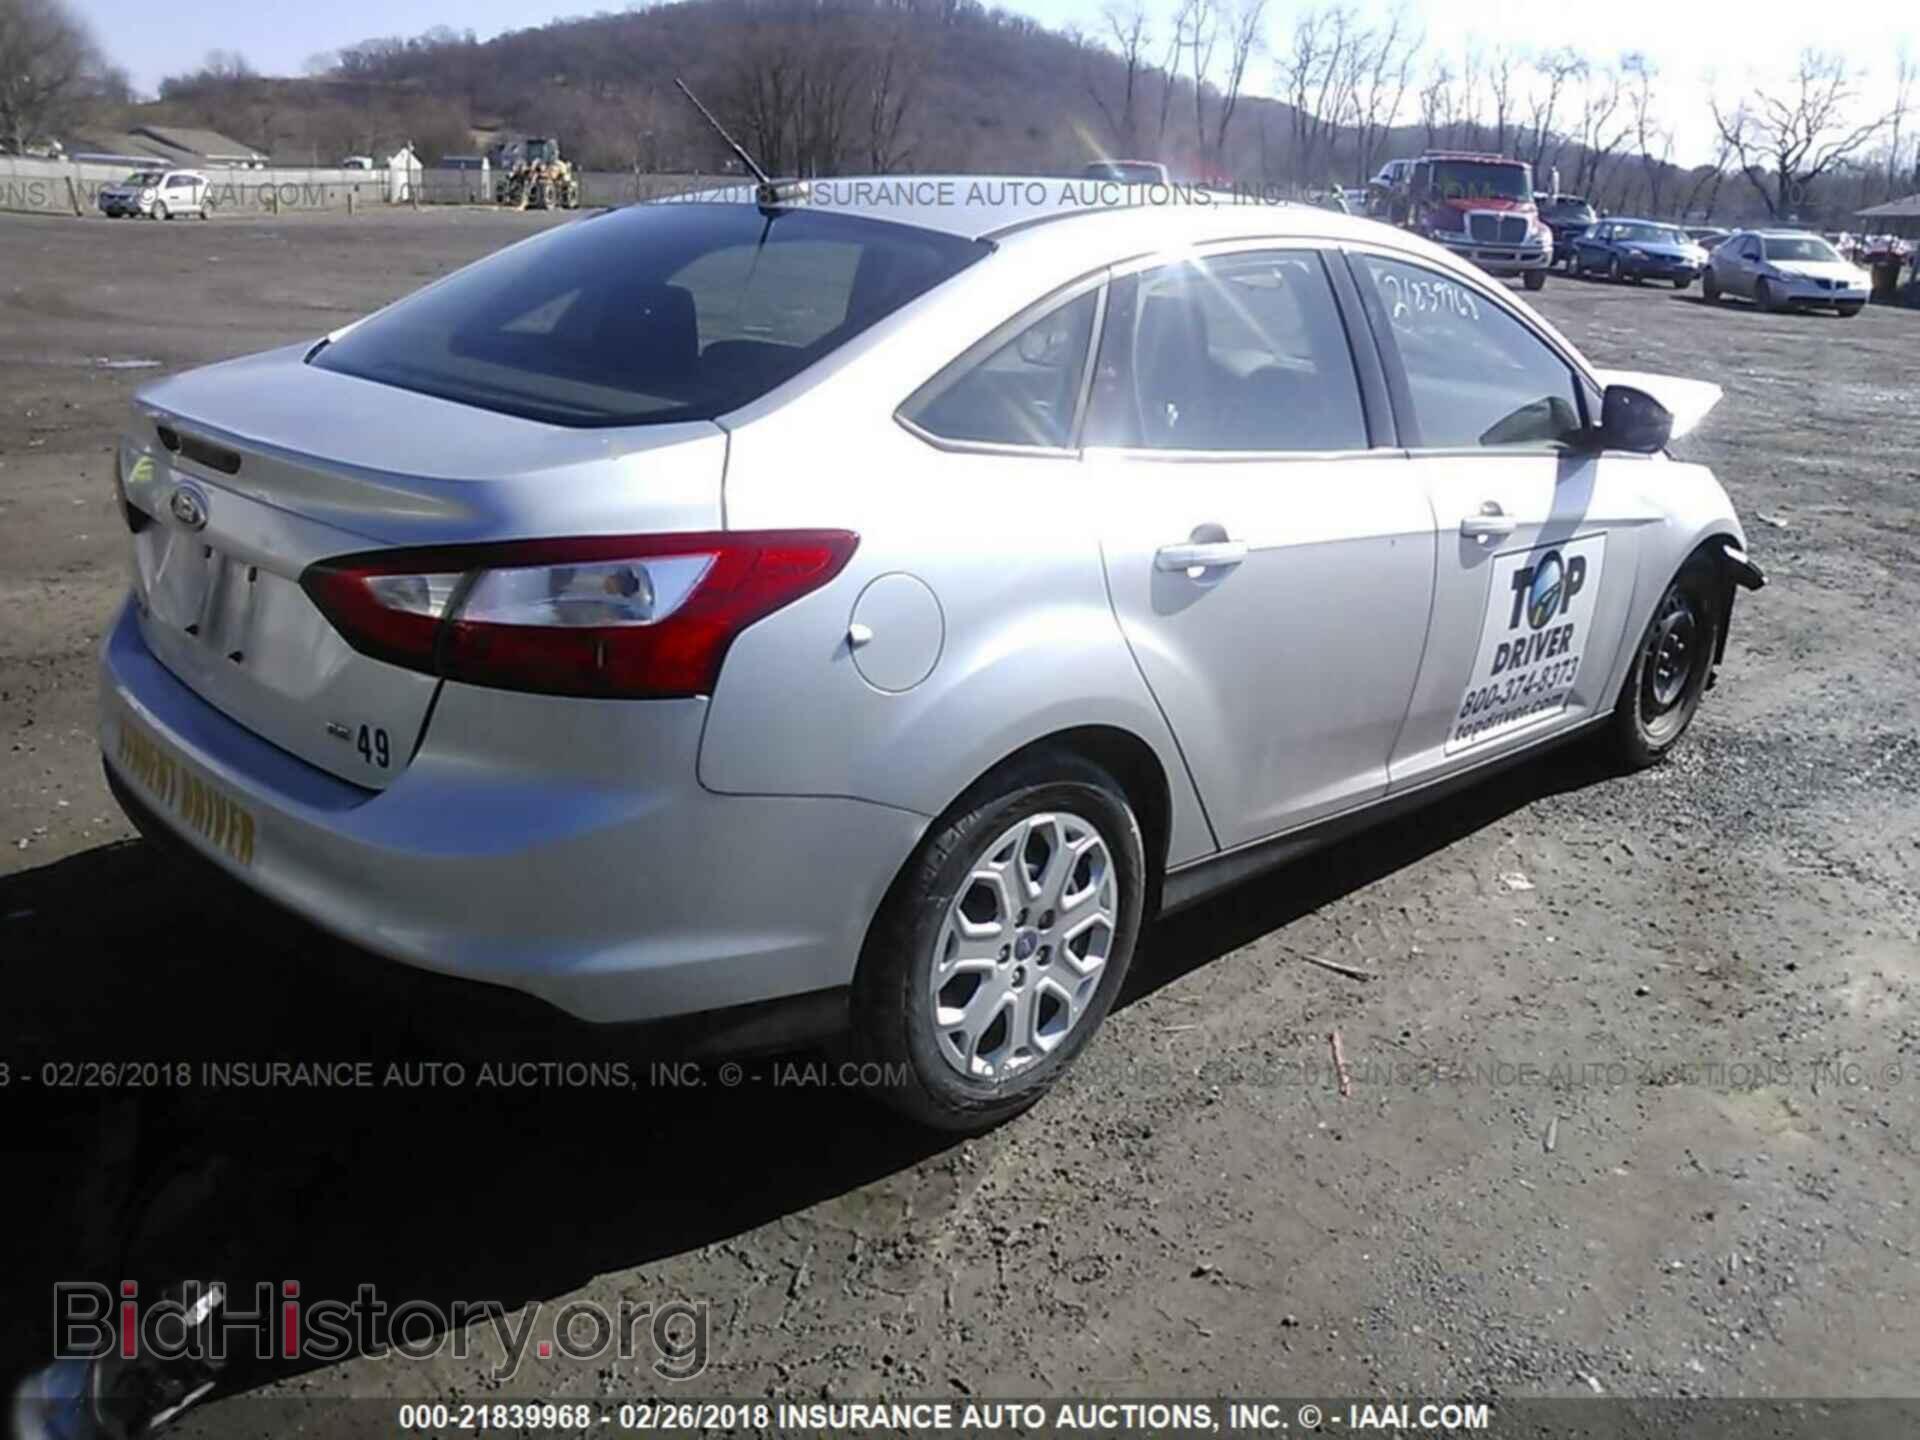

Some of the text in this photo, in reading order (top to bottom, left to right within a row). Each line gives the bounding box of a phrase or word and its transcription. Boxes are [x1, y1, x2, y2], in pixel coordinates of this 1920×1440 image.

[1508, 550, 1587, 630] TOP
[1490, 623, 1574, 677] DRIVER
[357, 724, 390, 769] 49
